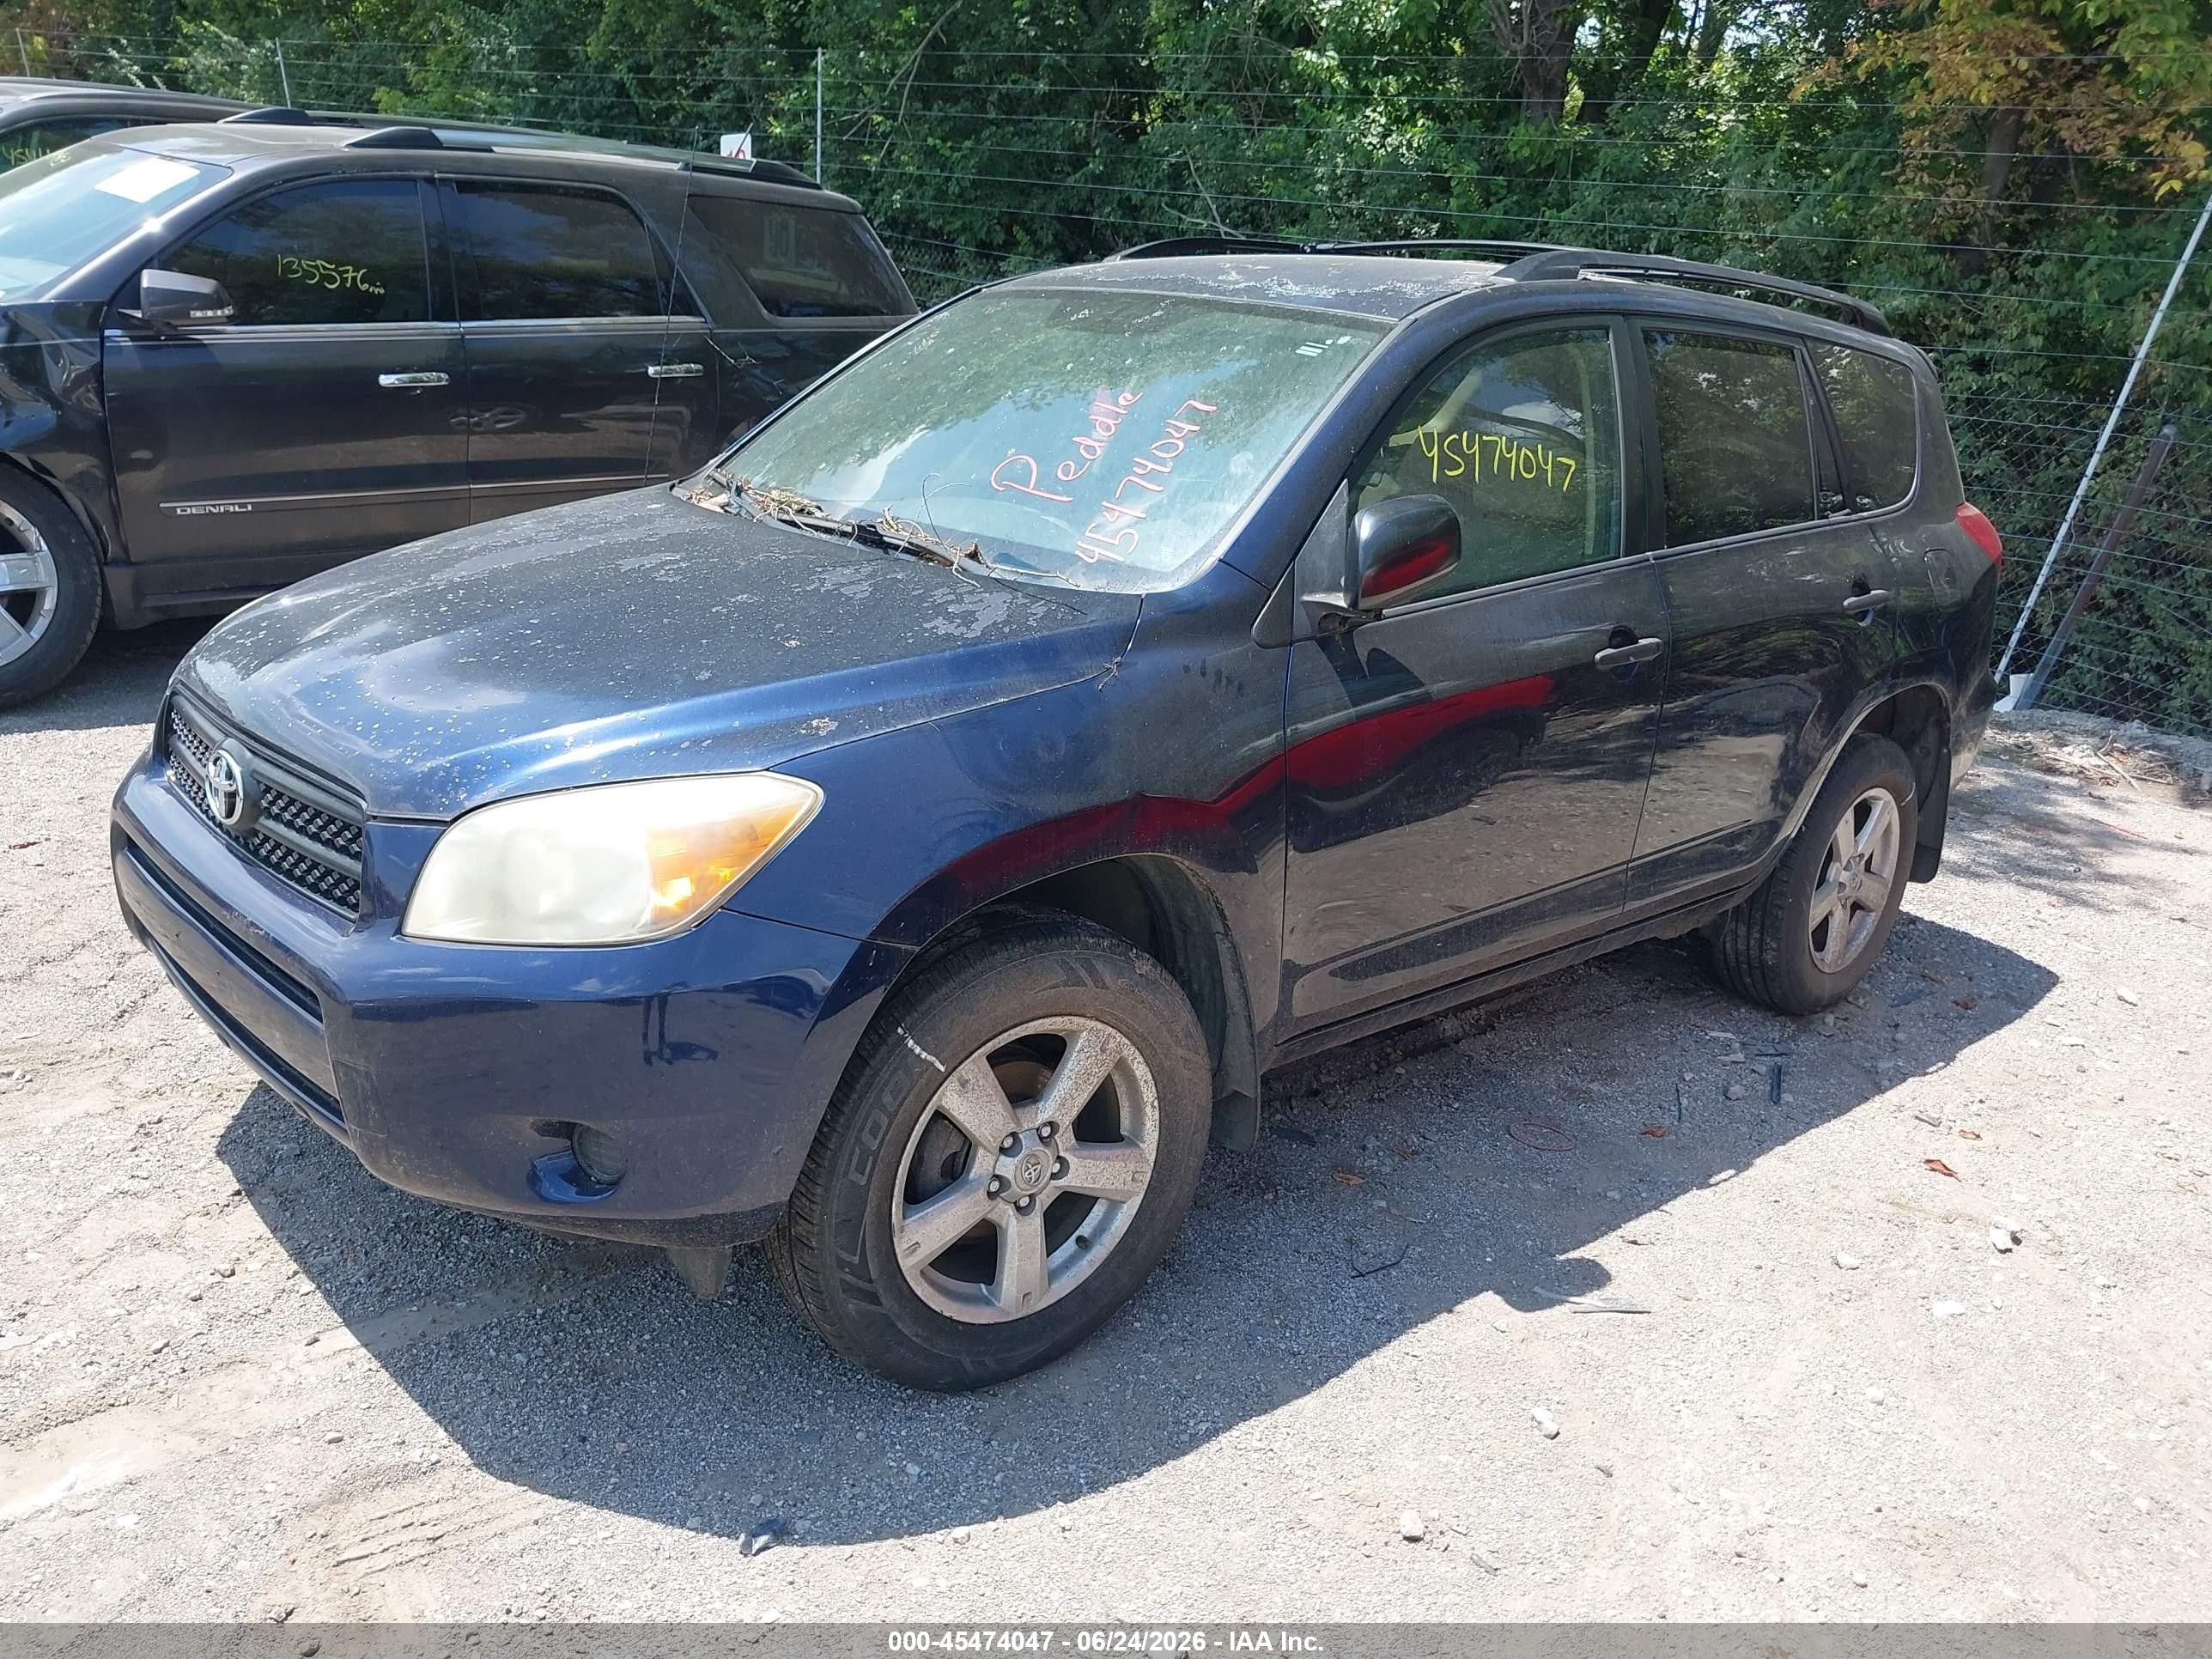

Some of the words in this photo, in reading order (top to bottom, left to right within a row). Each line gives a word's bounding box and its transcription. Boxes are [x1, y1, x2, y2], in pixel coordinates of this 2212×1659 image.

[990, 391, 1144, 503] Peddle
[1075, 398, 1218, 564] 45474047
[175, 503, 253, 515] DENALI
